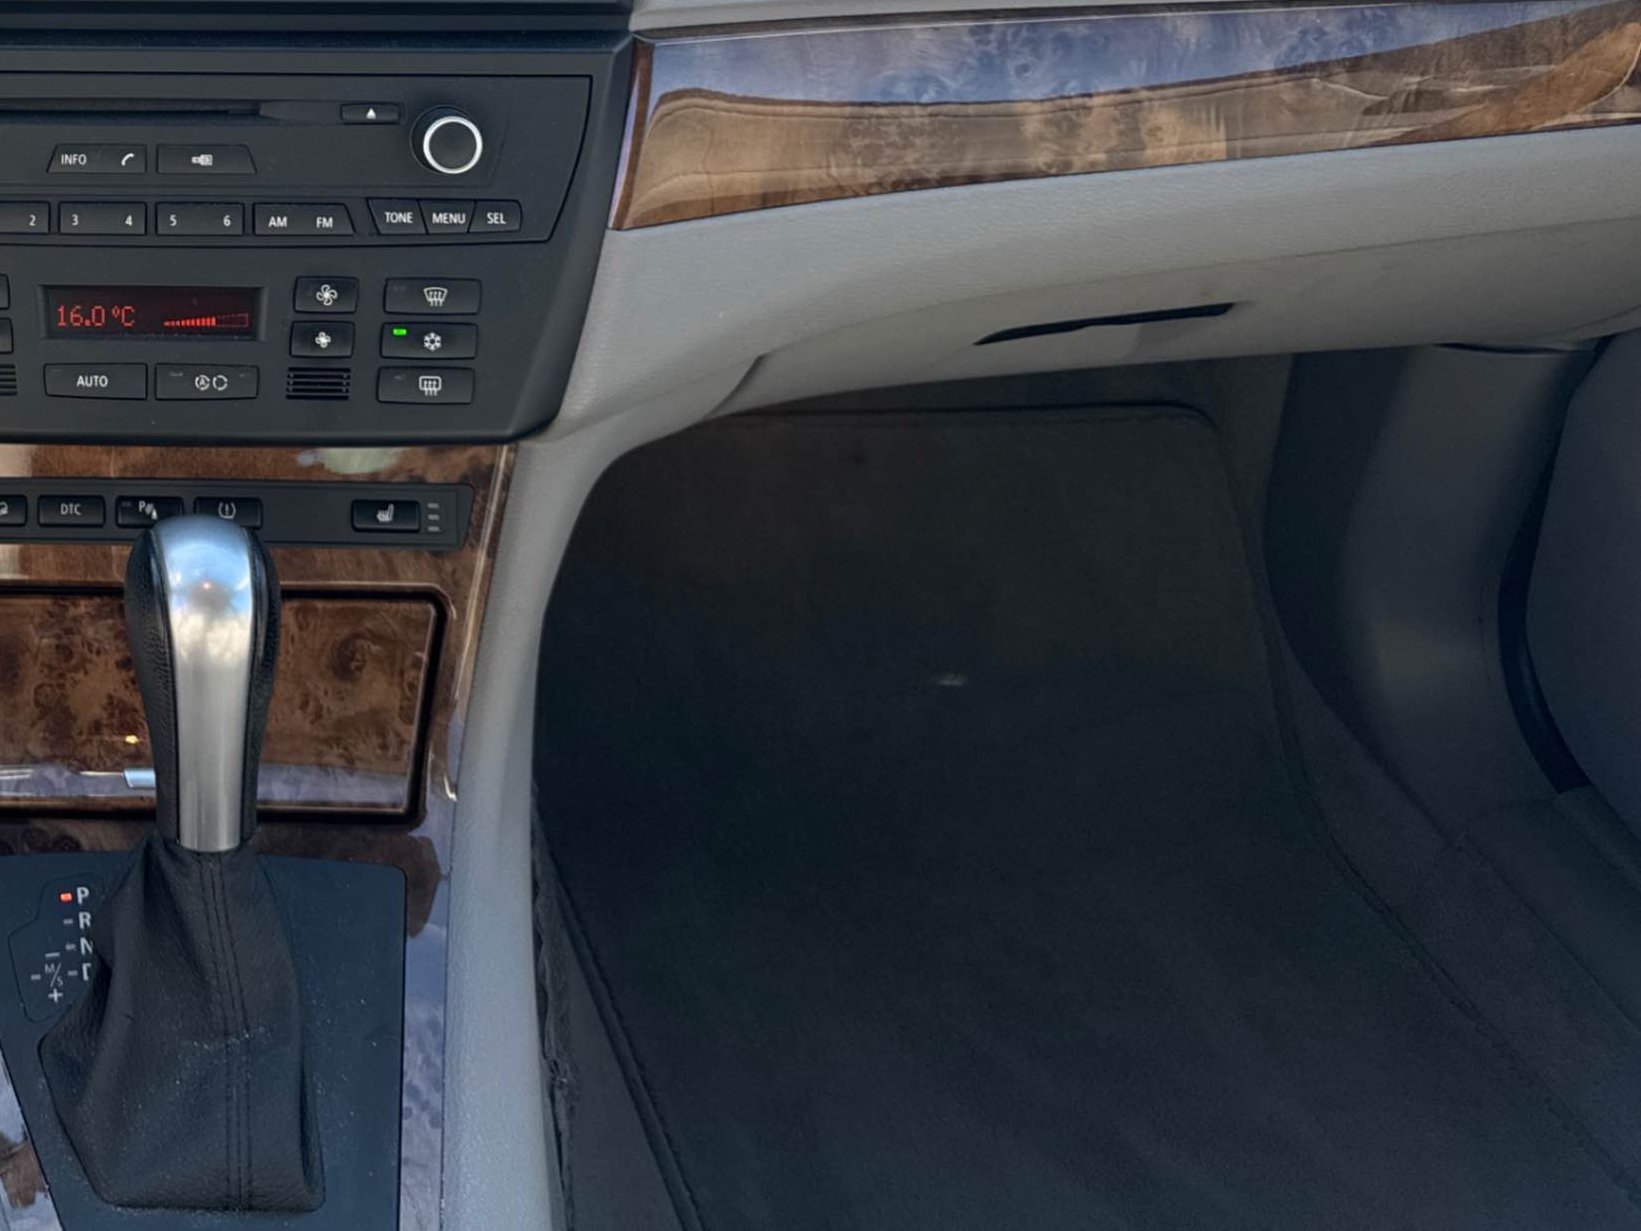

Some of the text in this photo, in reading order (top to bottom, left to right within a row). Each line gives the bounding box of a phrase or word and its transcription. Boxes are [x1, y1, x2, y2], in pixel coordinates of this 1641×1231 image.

[60, 154, 87, 166] INFO
[28, 215, 36, 226] 2
[71, 215, 133, 226] 3 4
[169, 215, 231, 227] 5 6
[268, 216, 333, 228] AM FM
[384, 212, 413, 224] TONE
[432, 213, 466, 224] MENU
[486, 213, 506, 224] SEL
[57, 305, 106, 327] 16.0
[76, 375, 108, 387] AUTO
[60, 503, 82, 516] DTC
[76, 886, 90, 905] P
[78, 911, 92, 930] R
